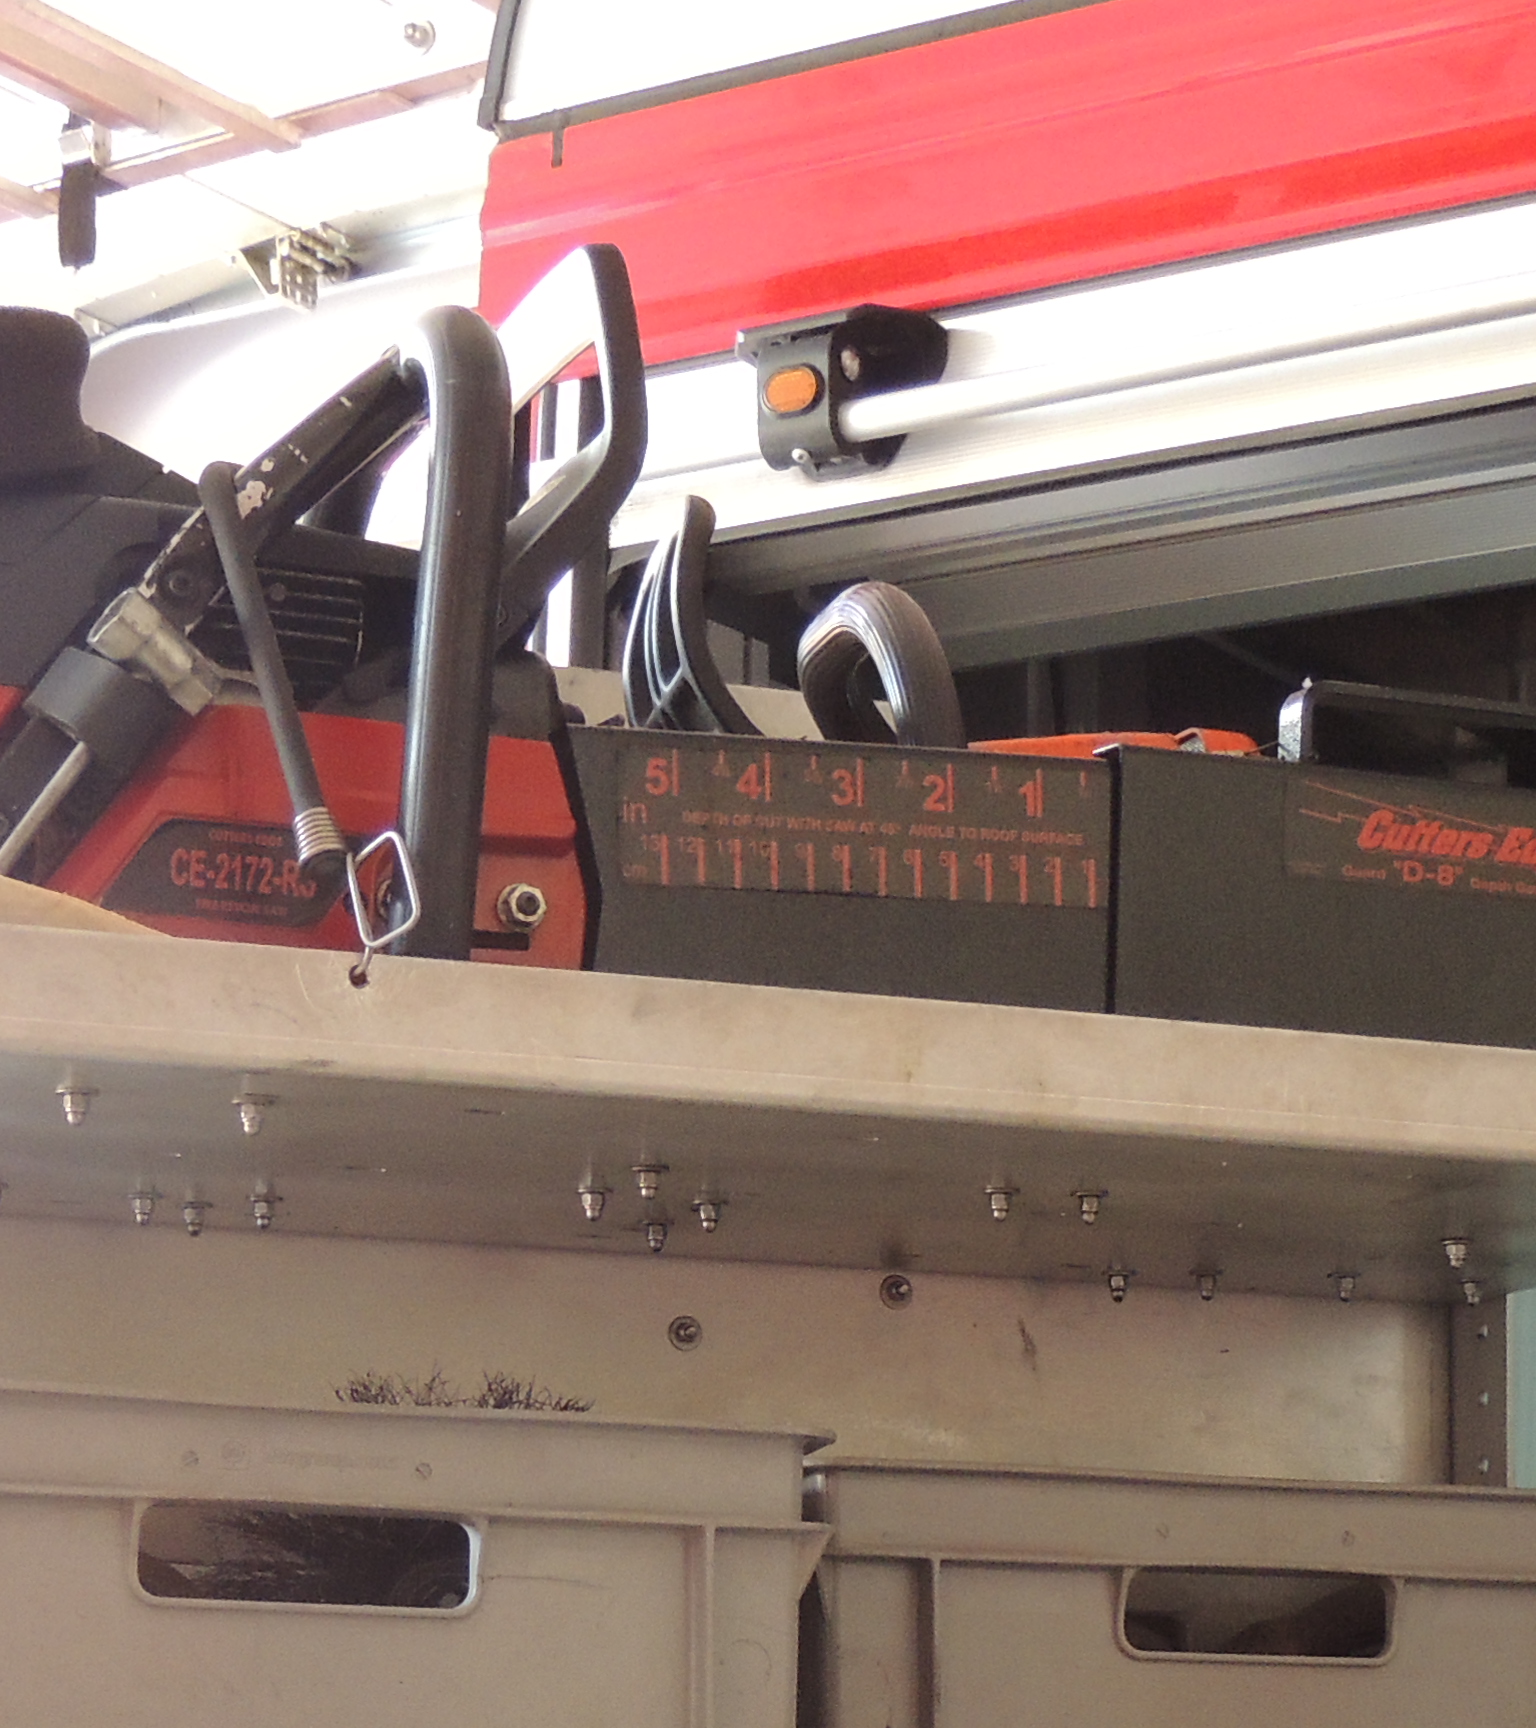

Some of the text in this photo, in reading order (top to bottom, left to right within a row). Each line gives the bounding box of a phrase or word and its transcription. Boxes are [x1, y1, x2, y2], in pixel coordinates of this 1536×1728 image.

[646, 757, 670, 796] 5
[736, 763, 762, 800] 4
[831, 769, 855, 806] 3
[922, 774, 946, 812] 2
[1019, 781, 1037, 817] 1
[623, 797, 648, 823] in
[909, 824, 955, 839] ANGLE
[959, 827, 978, 840] TO
[980, 828, 1018, 842] ROOF
[1021, 831, 1085, 846] SURFACE
[1357, 809, 1494, 859] Cutters
